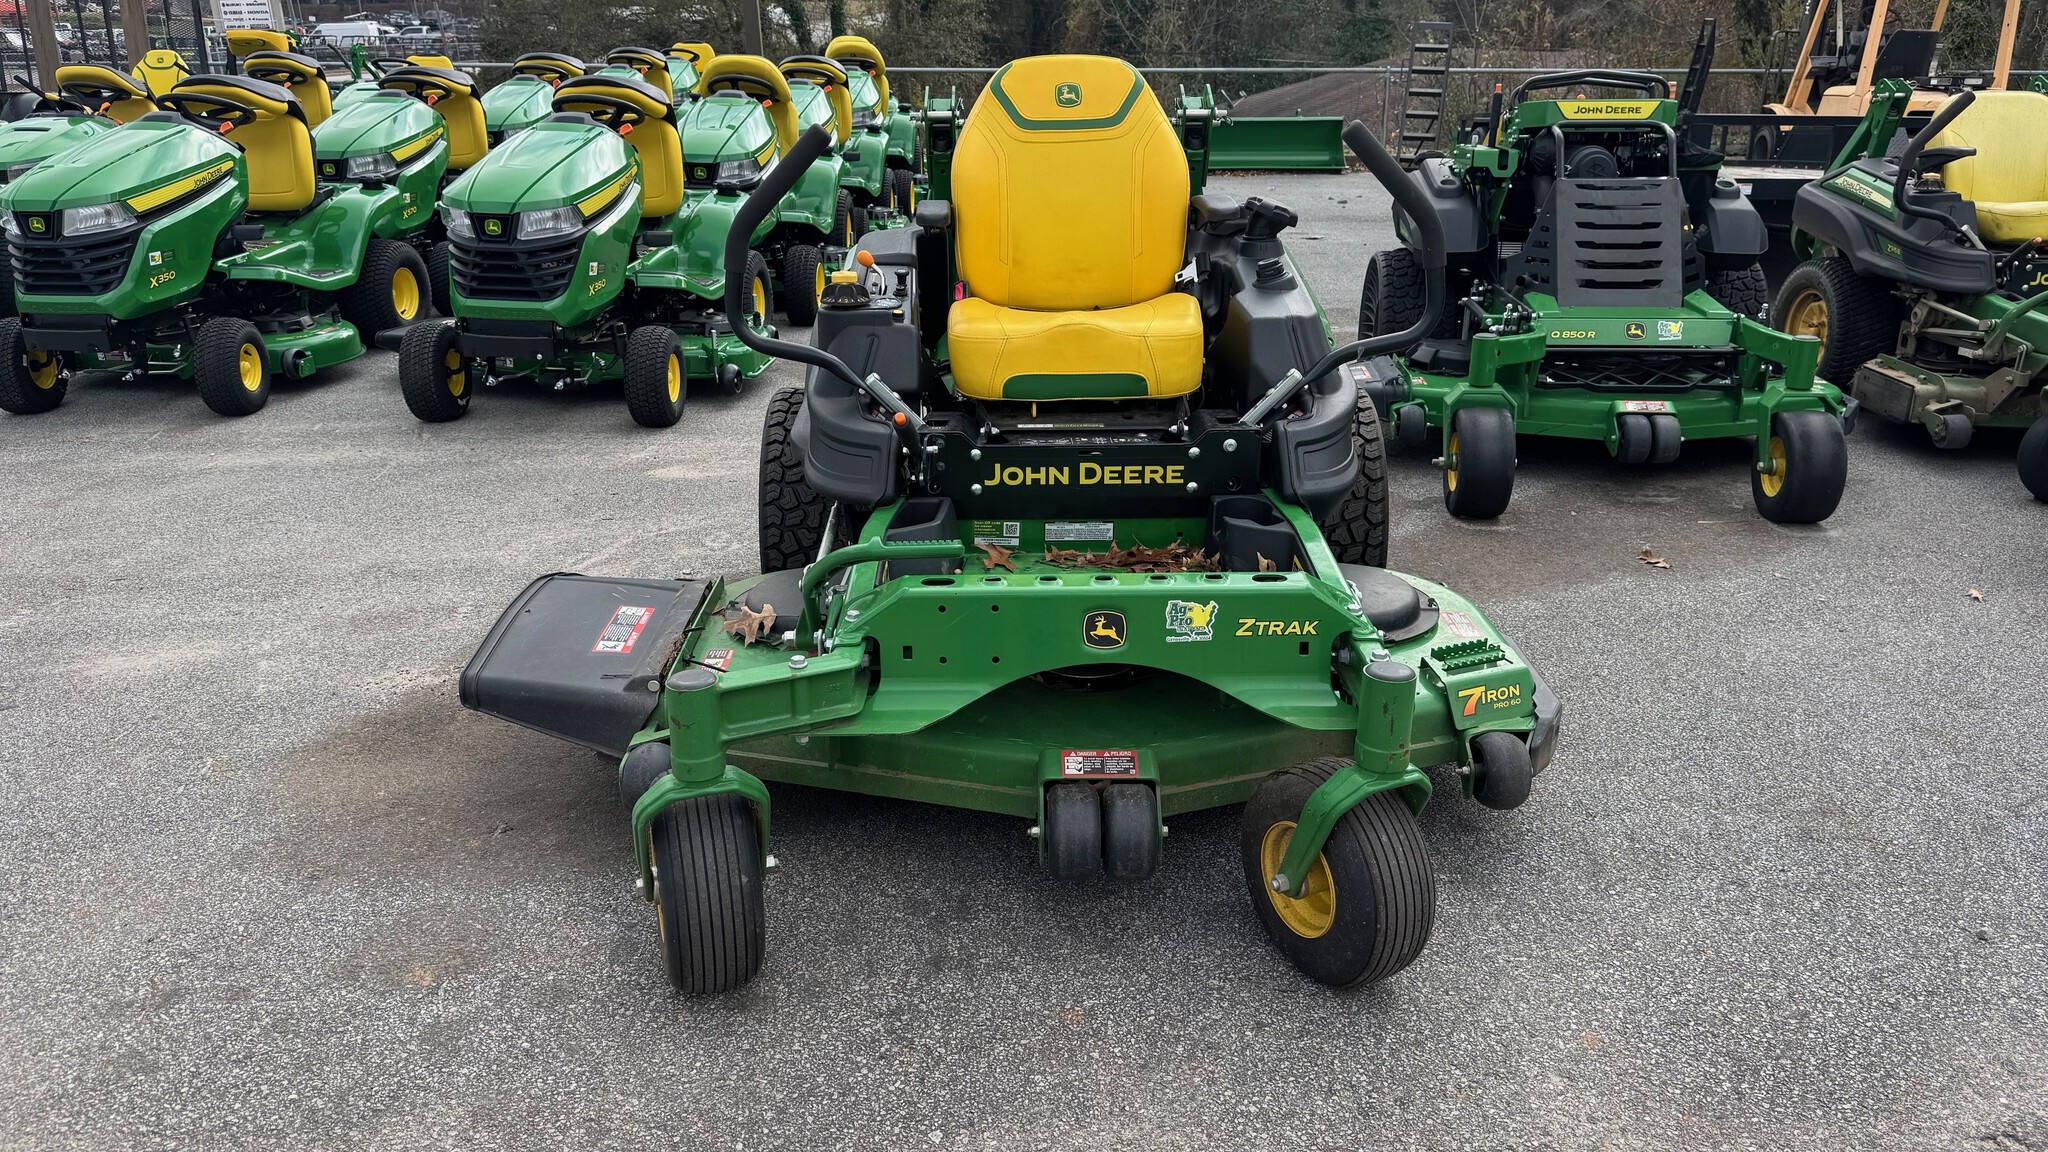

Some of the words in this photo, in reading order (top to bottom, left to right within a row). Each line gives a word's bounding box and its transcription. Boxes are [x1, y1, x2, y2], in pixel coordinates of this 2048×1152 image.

[1574, 105, 1603, 114] JOHN
[1605, 105, 1642, 114] DEERE
[193, 177, 208, 189] JOHN
[207, 166, 224, 183] DEERE
[149, 270, 176, 289] X350
[588, 278, 607, 297] X350
[1551, 330, 1561, 338] Q
[1562, 330, 1586, 338] 850
[1587, 330, 1597, 338] R
[984, 463, 1070, 486] JOHN
[1079, 462, 1185, 485] DEERE
[1170, 616, 1192, 627] Pro
[1235, 618, 1320, 636] ZTRAK
[1458, 685, 1486, 716] 7
[1481, 683, 1520, 704] IRON
[1493, 701, 1509, 709] PRO
[1510, 698, 1521, 706] 60
